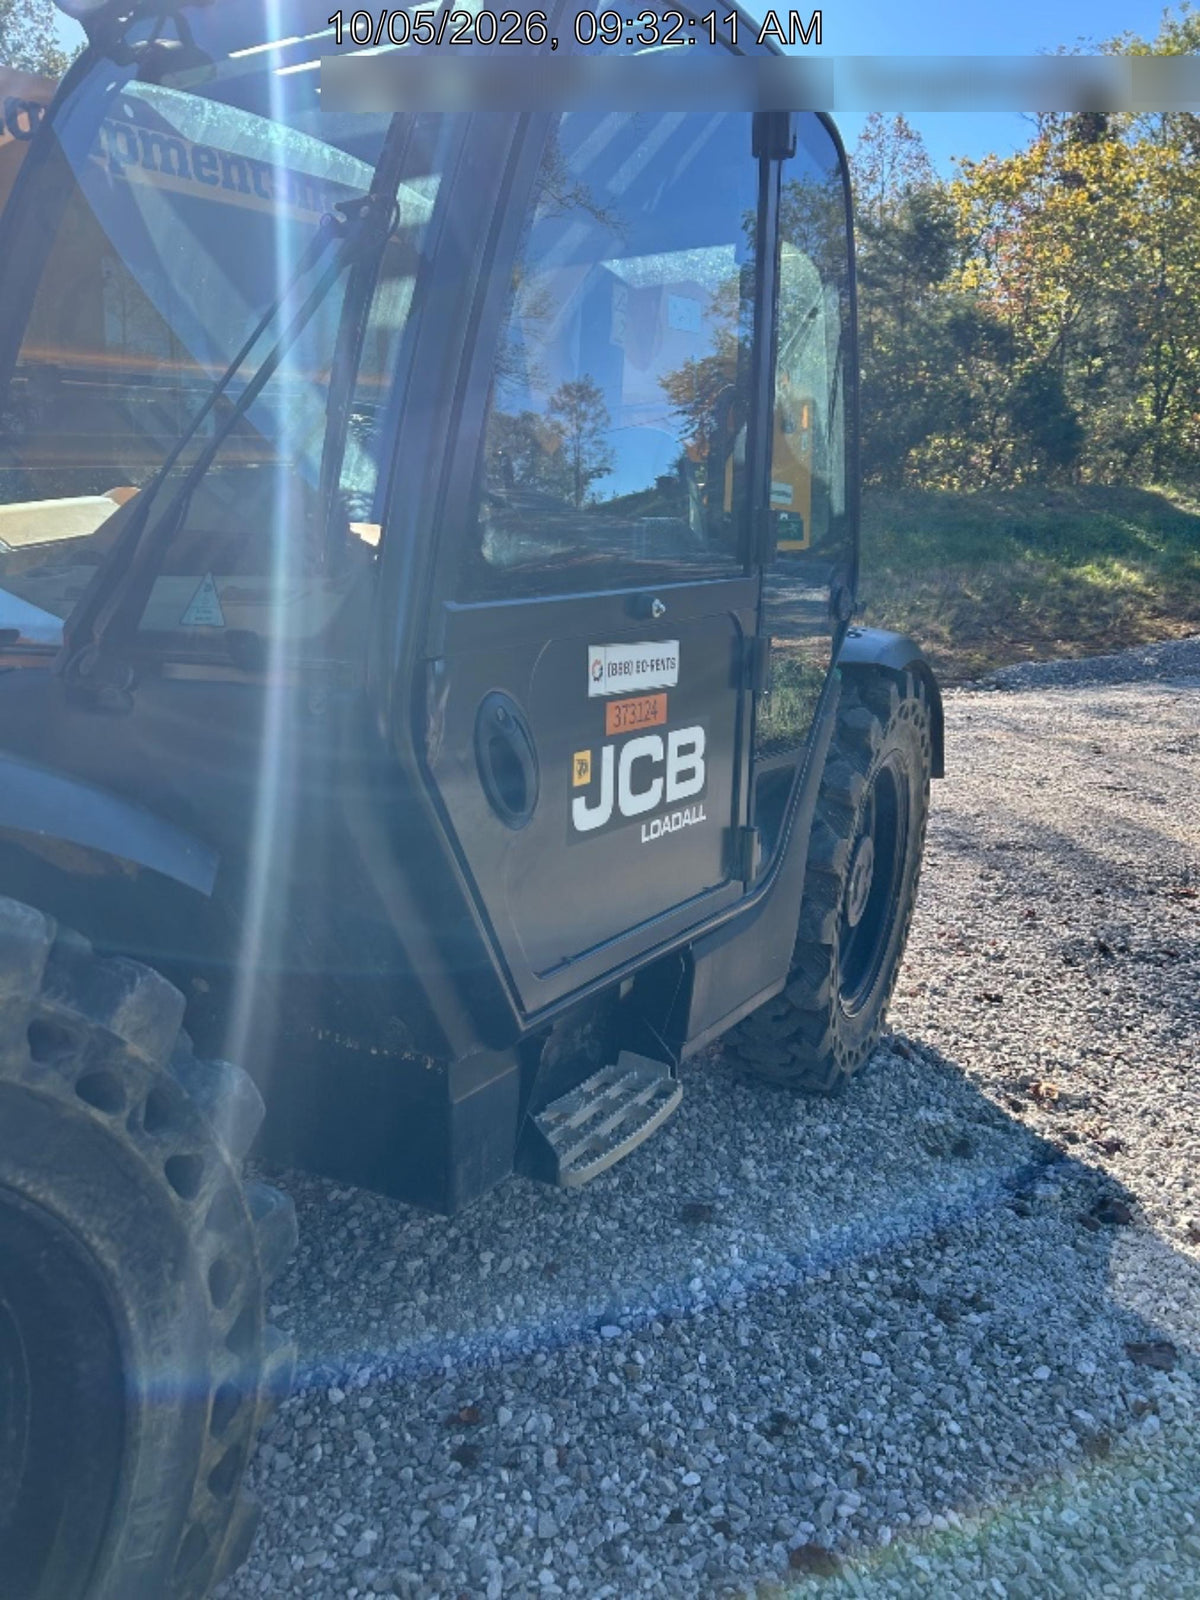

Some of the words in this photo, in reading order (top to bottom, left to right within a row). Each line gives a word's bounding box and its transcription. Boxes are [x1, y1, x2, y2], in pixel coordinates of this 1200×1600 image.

[612, 699, 659, 729] 373124
[571, 725, 706, 832] JCB
[640, 804, 707, 844] LOADALL
